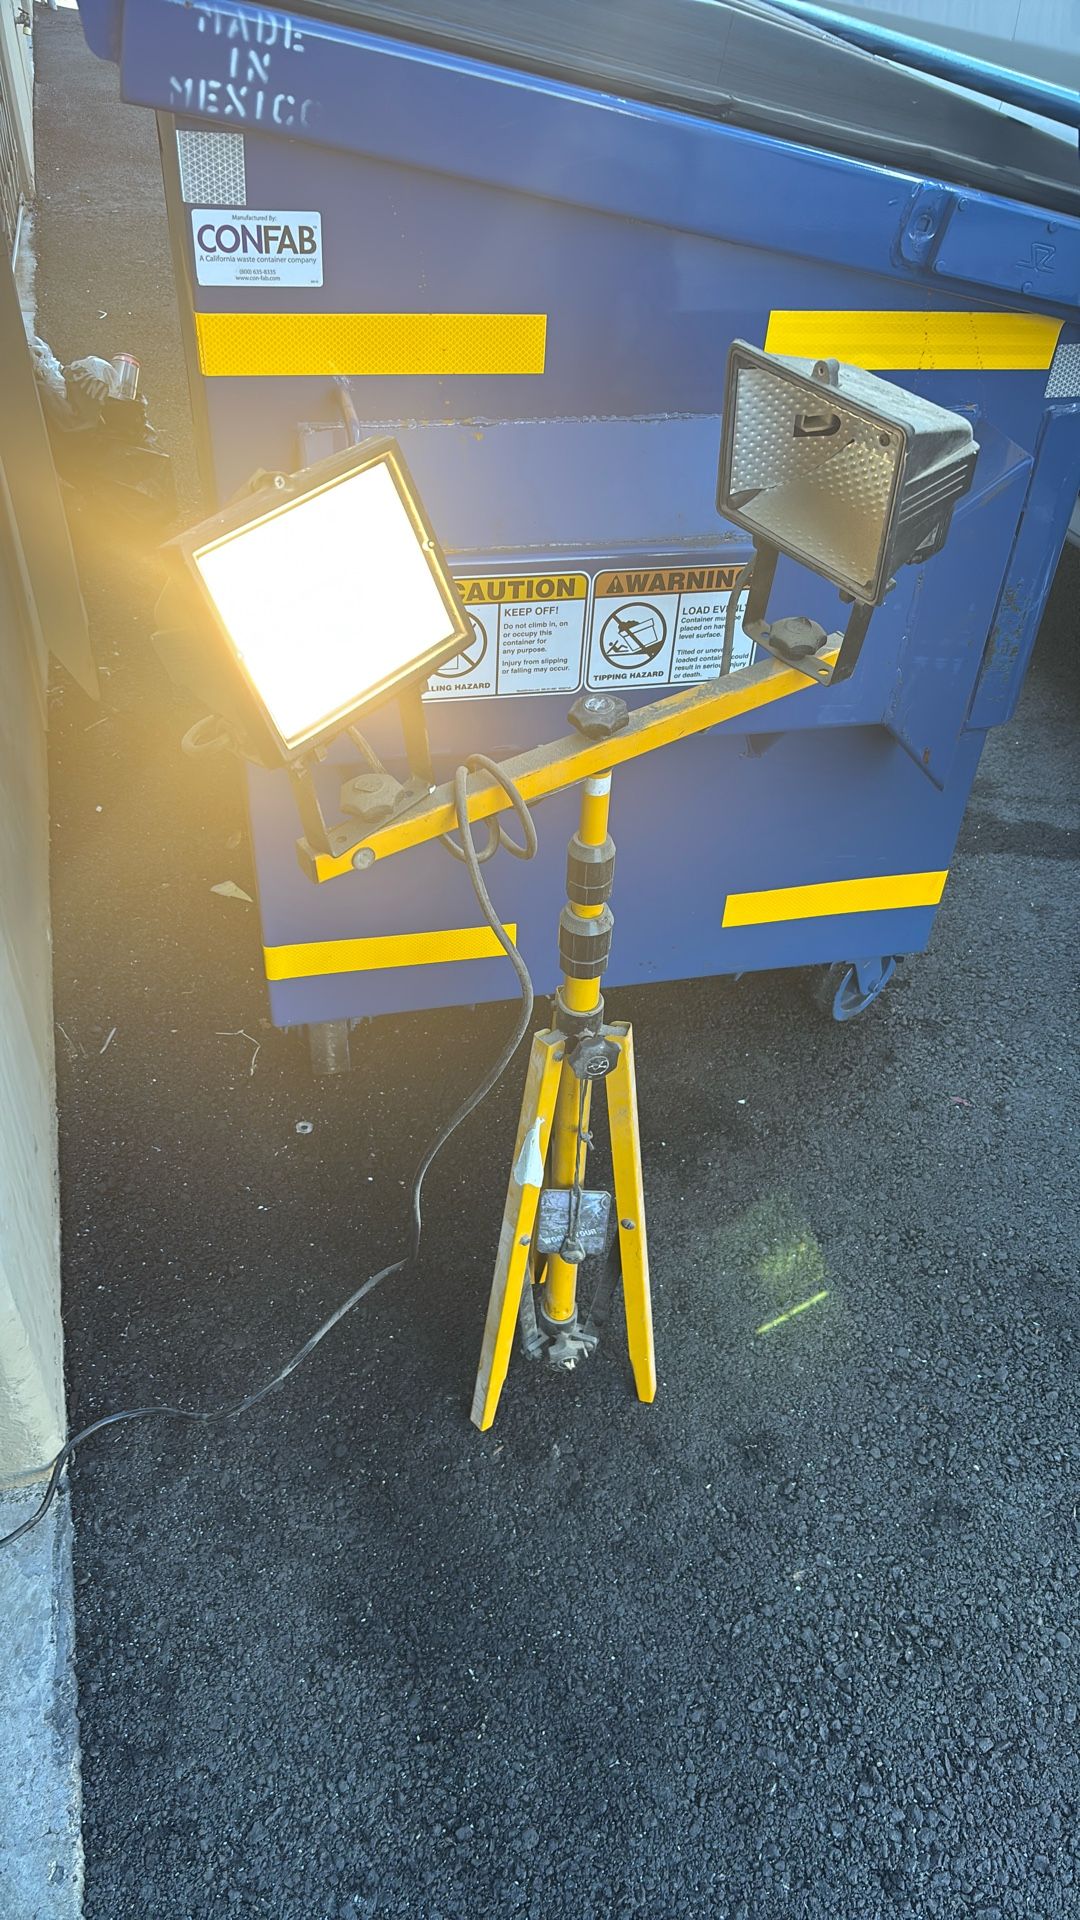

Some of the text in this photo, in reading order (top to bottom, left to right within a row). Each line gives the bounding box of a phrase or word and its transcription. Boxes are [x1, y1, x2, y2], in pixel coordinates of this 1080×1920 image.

[198, 6, 304, 52] MADE
[229, 47, 270, 83] IN
[197, 223, 317, 254] CONFAB
[205, 255, 236, 263] California
[287, 257, 317, 265] company
[504, 606, 559, 617] KEEP OFF!
[682, 604, 746, 615] LOAD EVL
[680, 615, 713, 624] Container
[679, 625, 702, 633] placed
[512, 631, 538, 639] occupy
[541, 657, 568, 665] slipping
[675, 656, 698, 664] loaded
[511, 667, 532, 675] falling
[593, 670, 664, 681] TIPPING HAZARD
[431, 682, 491, 692] LING HAZARD
